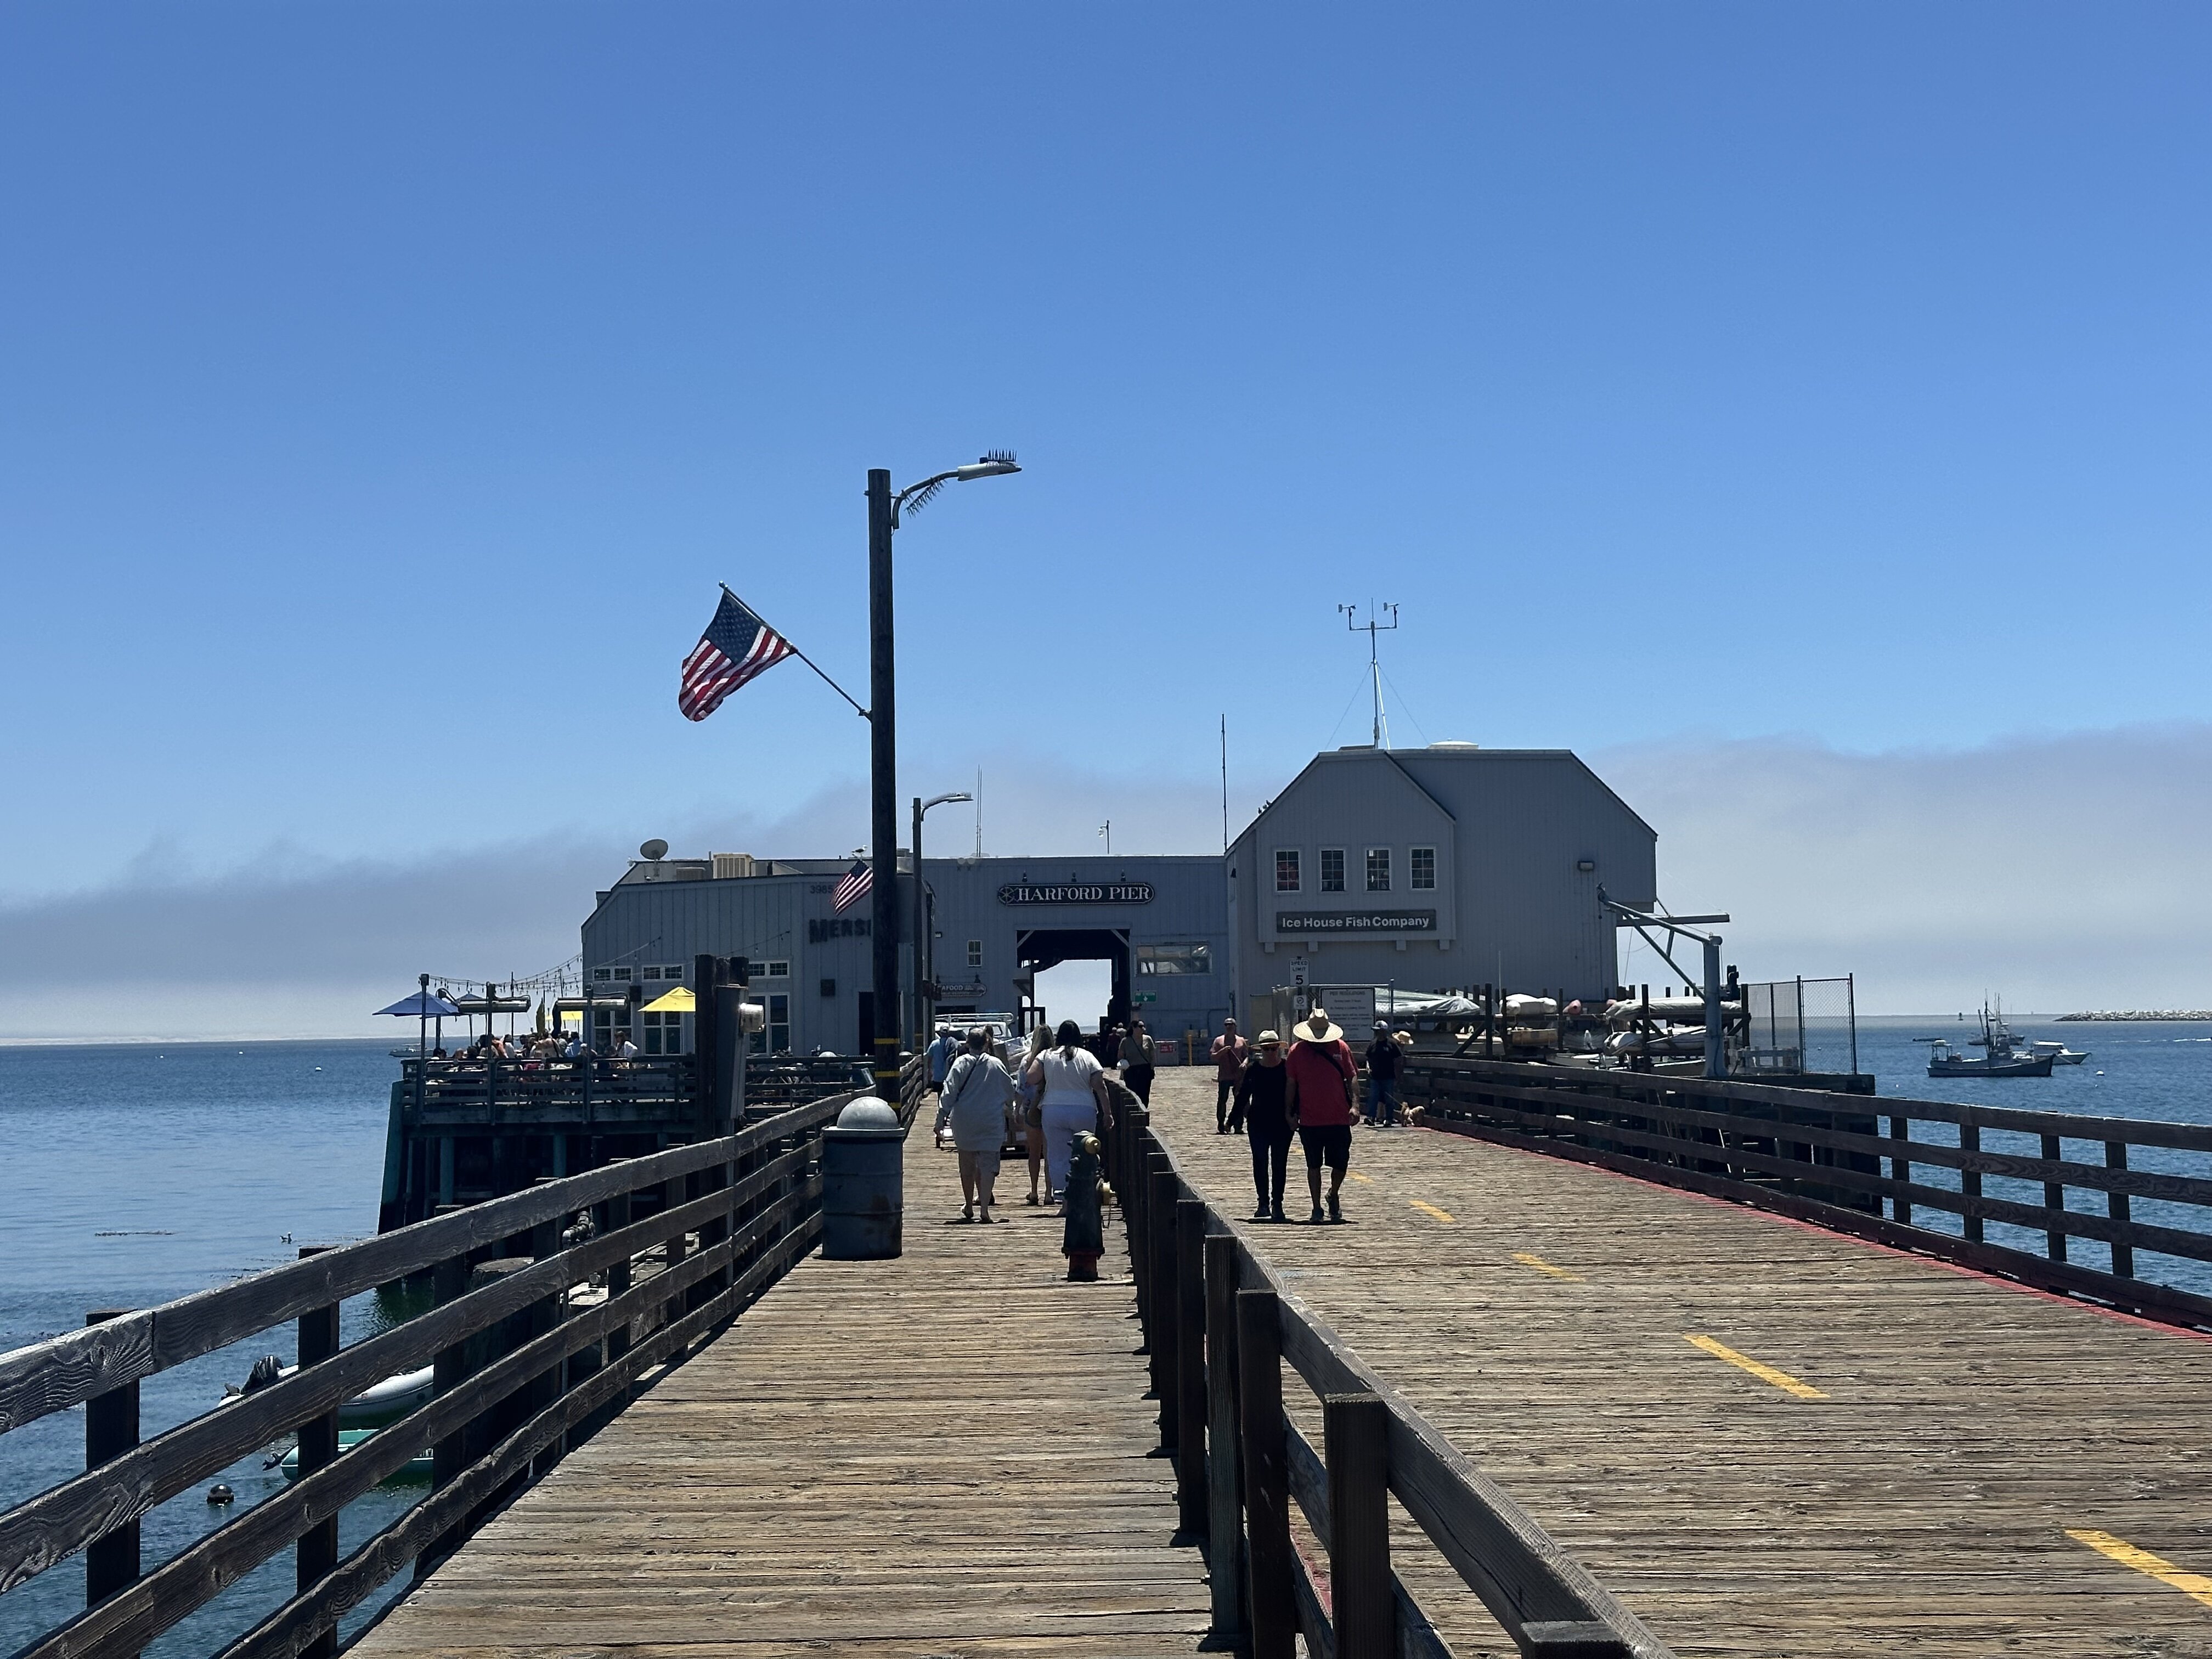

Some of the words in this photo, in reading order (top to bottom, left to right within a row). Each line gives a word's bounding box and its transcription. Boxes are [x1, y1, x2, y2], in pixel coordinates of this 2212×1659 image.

[1018, 887, 1103, 901] HARFORD
[1109, 886, 1151, 900] PIER
[1282, 917, 1301, 928] Ice
[1304, 917, 1343, 928] House
[1346, 916, 1372, 927] Fish
[1372, 916, 1430, 928] Company
[1295, 974, 1304, 985] 5
